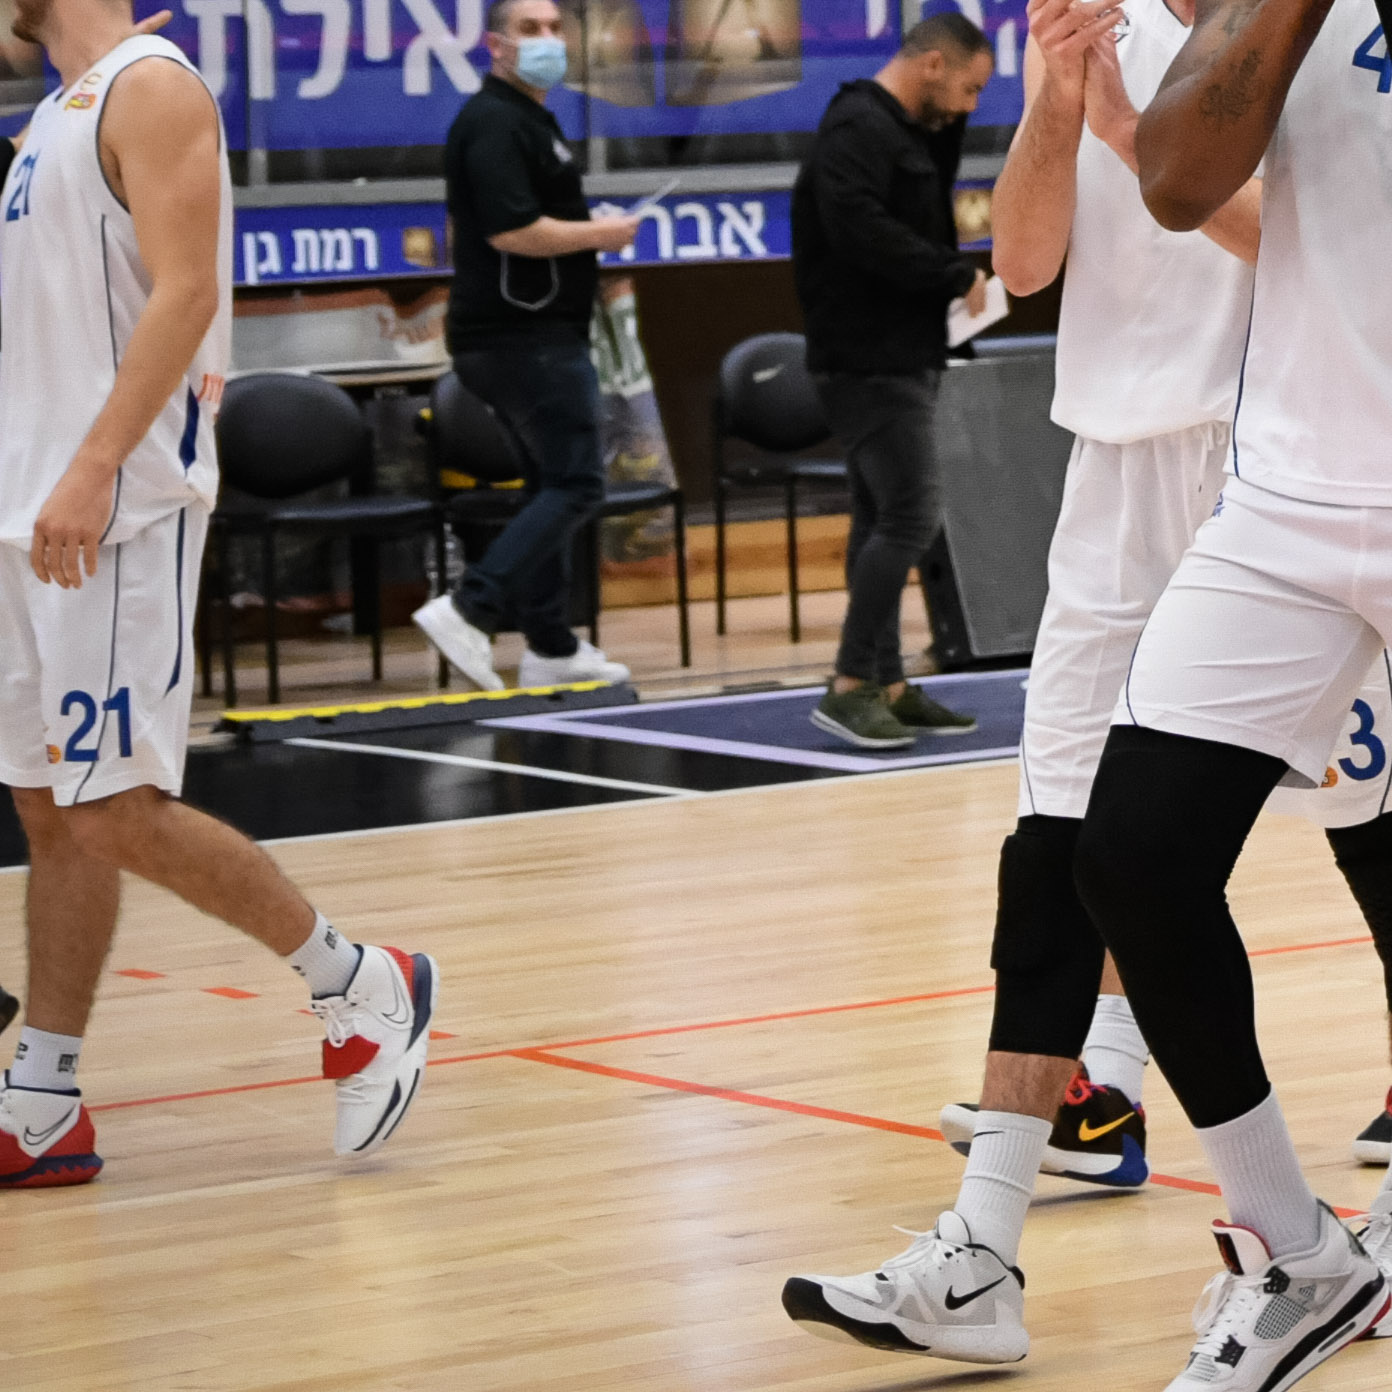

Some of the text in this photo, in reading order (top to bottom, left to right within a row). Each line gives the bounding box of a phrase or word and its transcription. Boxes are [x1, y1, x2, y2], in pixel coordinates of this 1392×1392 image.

[243, 228, 380, 285] רמת גן
[60, 686, 133, 763] 21
